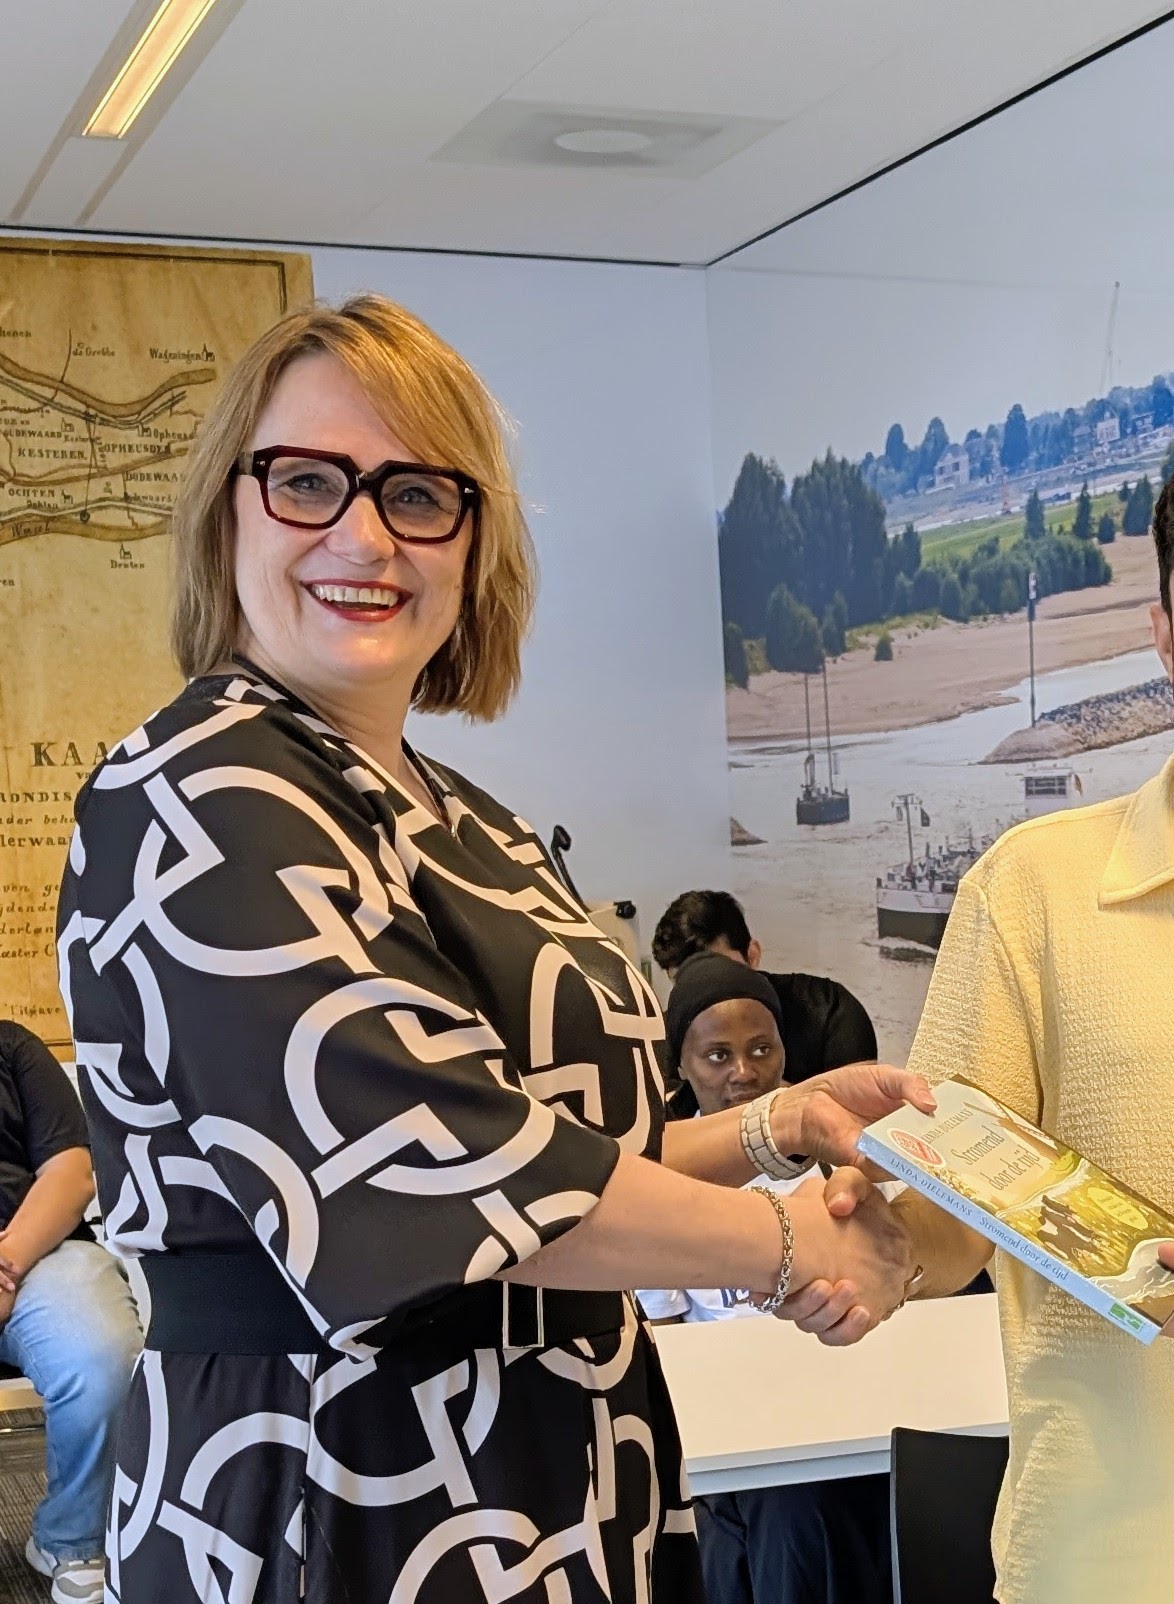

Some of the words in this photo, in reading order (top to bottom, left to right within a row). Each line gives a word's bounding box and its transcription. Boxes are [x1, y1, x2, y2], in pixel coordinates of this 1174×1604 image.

[951, 1124, 1005, 1165] Stromend
[980, 1168, 1015, 1191] door
[890, 1158, 918, 1180] LINDA
[920, 1179, 973, 1216] DIELEMANS
[980, 1217, 1021, 1249] Stromend
[1020, 1245, 1040, 1262] door
[1041, 1258, 1051, 1269] de
[1052, 1267, 1069, 1280] tijd
